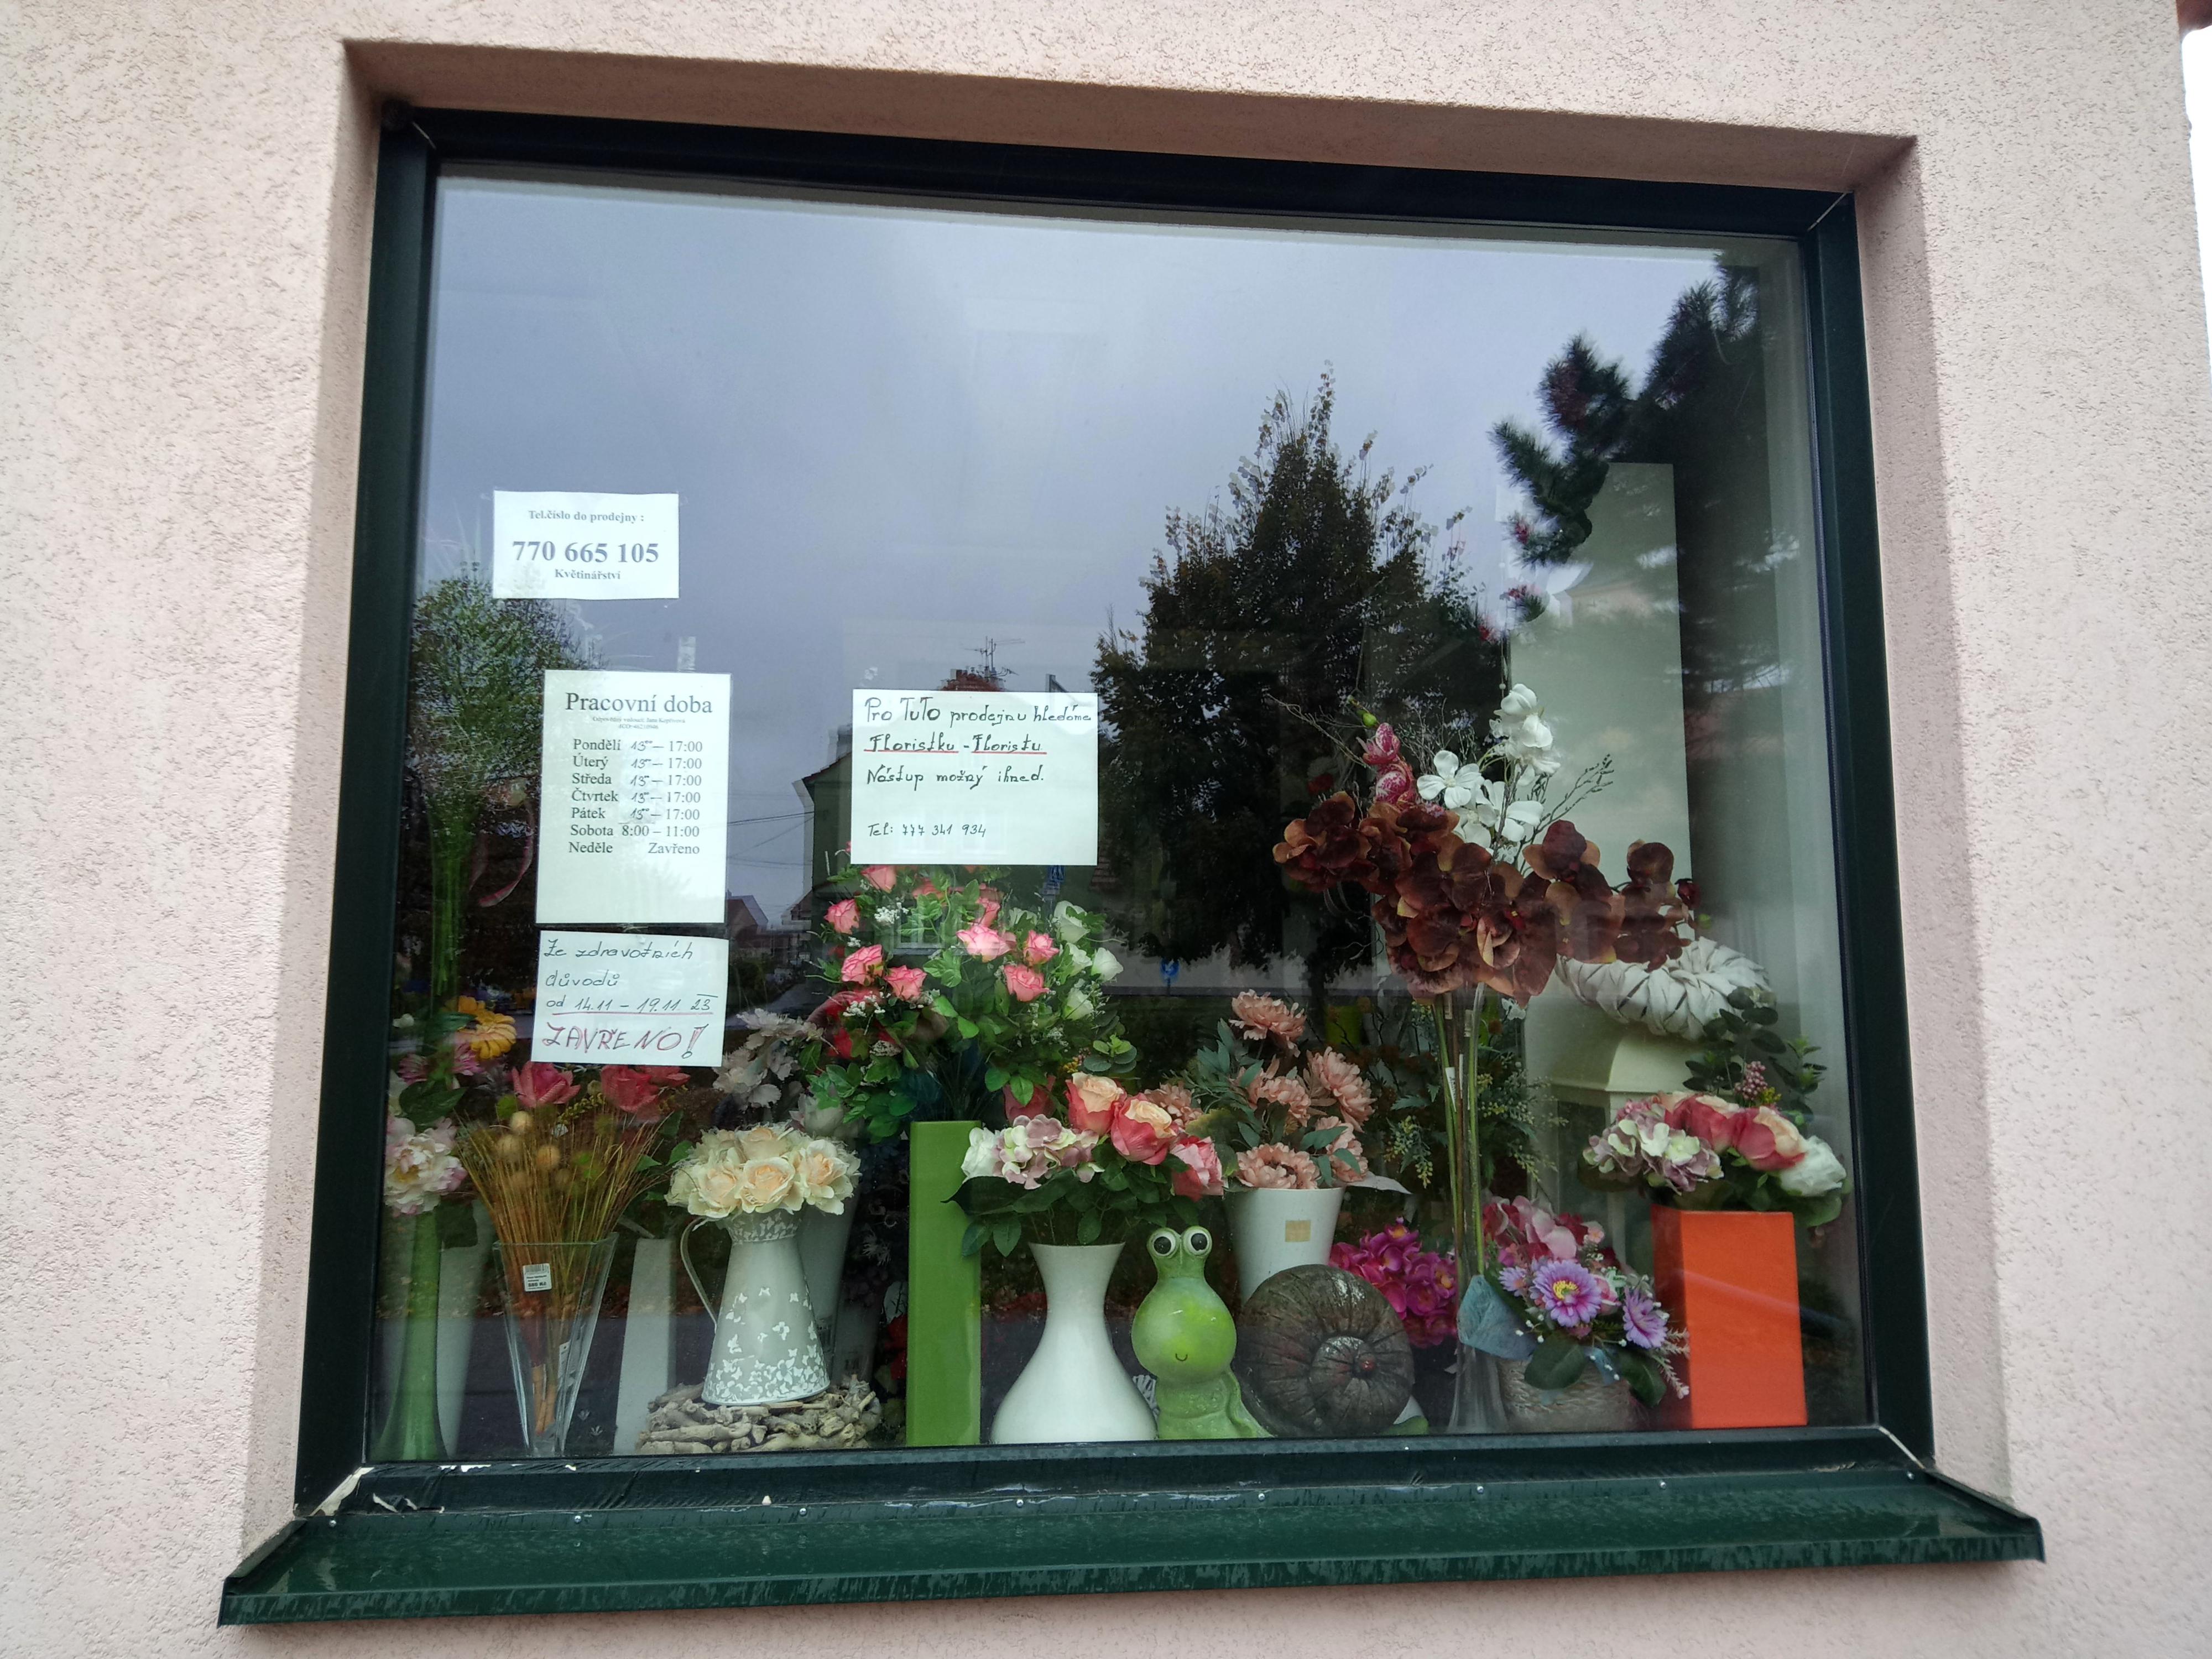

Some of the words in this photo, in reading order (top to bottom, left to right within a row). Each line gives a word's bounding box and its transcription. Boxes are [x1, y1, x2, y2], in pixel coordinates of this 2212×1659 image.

[574, 511, 587, 521] do
[590, 512, 637, 524] prodejny
[513, 541, 556, 561] 770
[565, 542, 608, 563] 665
[619, 543, 659, 563] 105
[555, 568, 621, 580] Květinářství
[565, 692, 657, 712] Pracovní
[664, 695, 713, 713] doba
[865, 697, 893, 722] Pro
[950, 705, 1027, 728] prodejnu
[1034, 705, 1092, 722] hledáme
[573, 738, 622, 752] Pondělí
[670, 740, 703, 752] 17:00
[573, 753, 609, 770] Úterý
[669, 758, 702, 769] 17:00
[572, 773, 612, 785] Středa
[669, 774, 702, 786] 17:00
[867, 764, 924, 791] Nástup
[937, 765, 988, 790] možný
[572, 787, 619, 802] Čtvrtek
[667, 791, 701, 803] 17:00
[572, 807, 606, 819] Pátek
[667, 808, 700, 820] 17:00
[571, 824, 614, 836] Sobota
[622, 825, 649, 837] 8:00
[667, 826, 700, 837] 11:00
[868, 822, 894, 837] Tel:
[932, 823, 952, 836] 341
[962, 824, 987, 838] 934
[569, 842, 613, 853] Neděle
[648, 842, 700, 854] Zavřeno
[546, 969, 620, 987] důvodů
[546, 994, 566, 1008] od
[574, 997, 612, 1011] 14.11
[691, 998, 711, 1011] 23
